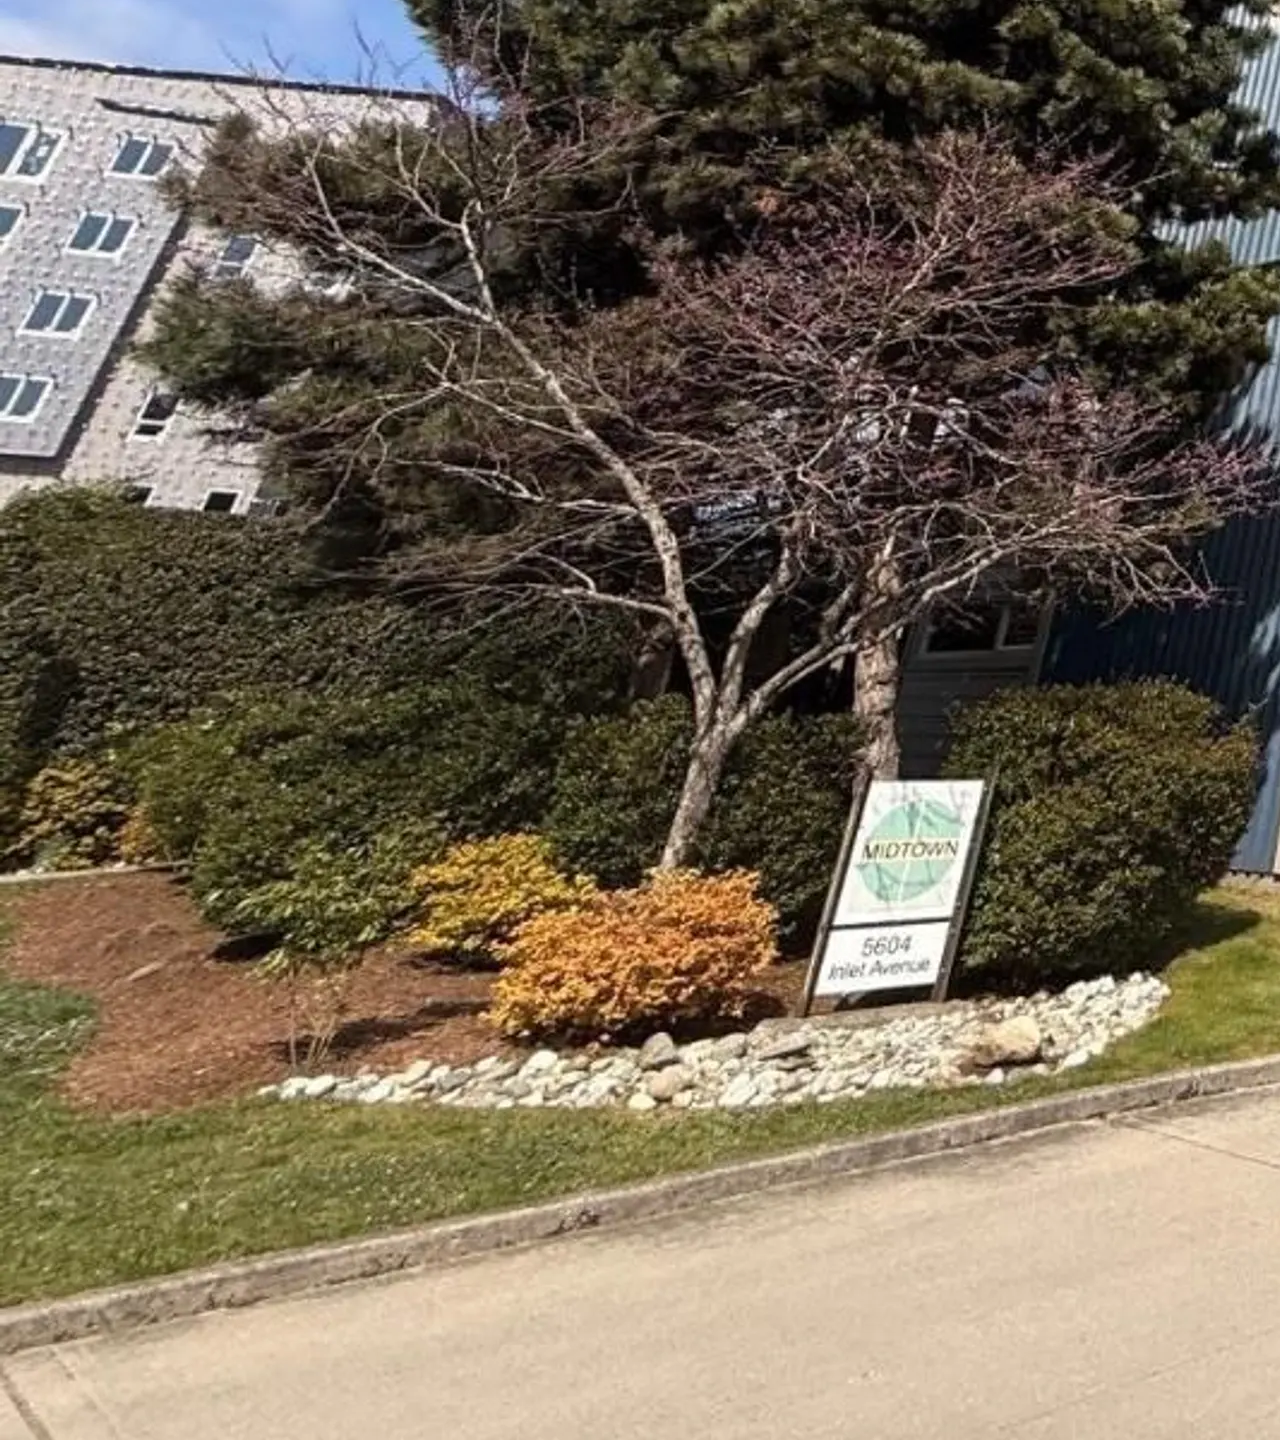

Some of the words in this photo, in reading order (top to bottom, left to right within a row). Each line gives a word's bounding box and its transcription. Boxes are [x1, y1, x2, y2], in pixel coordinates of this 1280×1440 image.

[862, 839, 959, 859] MIDTOWN
[861, 935, 912, 957] 5604
[828, 961, 865, 980] Inlet
[868, 959, 930, 976] Avenue
